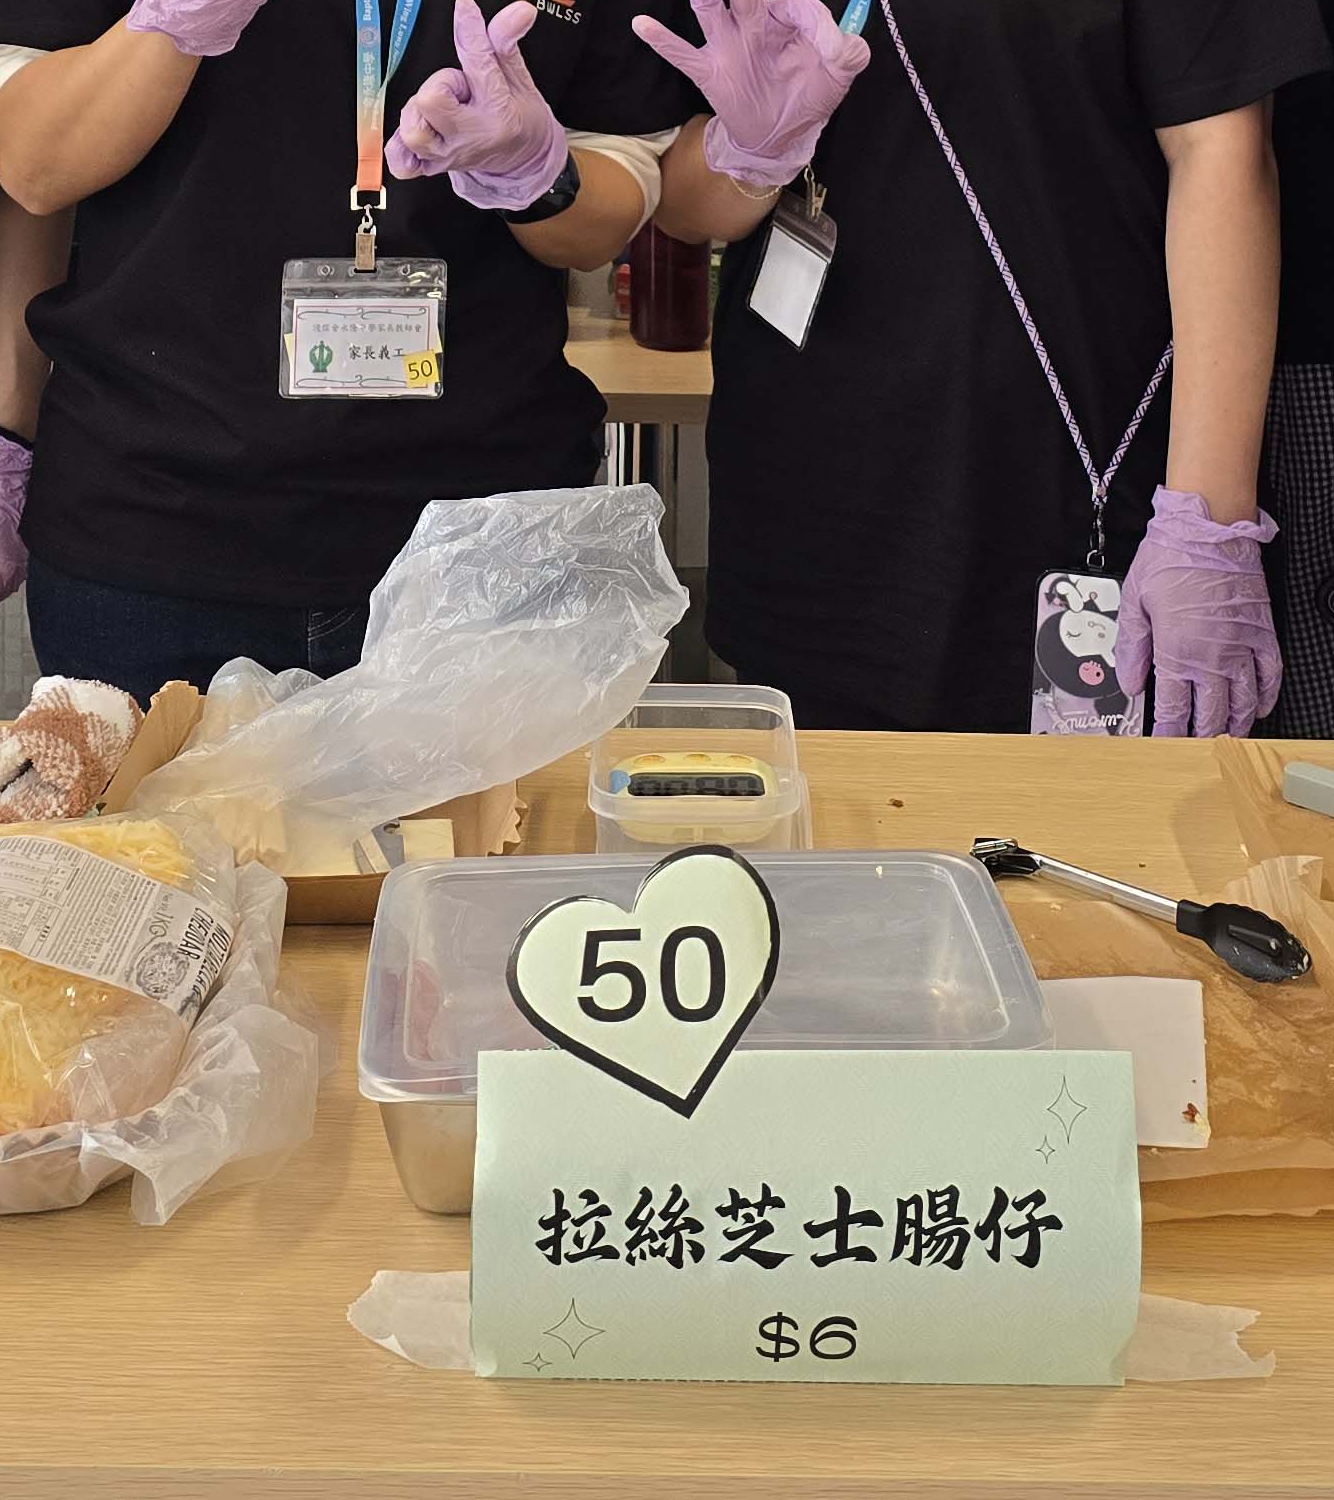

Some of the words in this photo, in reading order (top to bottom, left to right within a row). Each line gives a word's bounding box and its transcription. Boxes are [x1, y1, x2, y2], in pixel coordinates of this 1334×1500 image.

[408, 360, 433, 380] 50
[576, 926, 727, 1024] 50
[537, 1183, 1065, 1273] 拉絲芝士腸仔
[756, 1311, 858, 1364] $6
